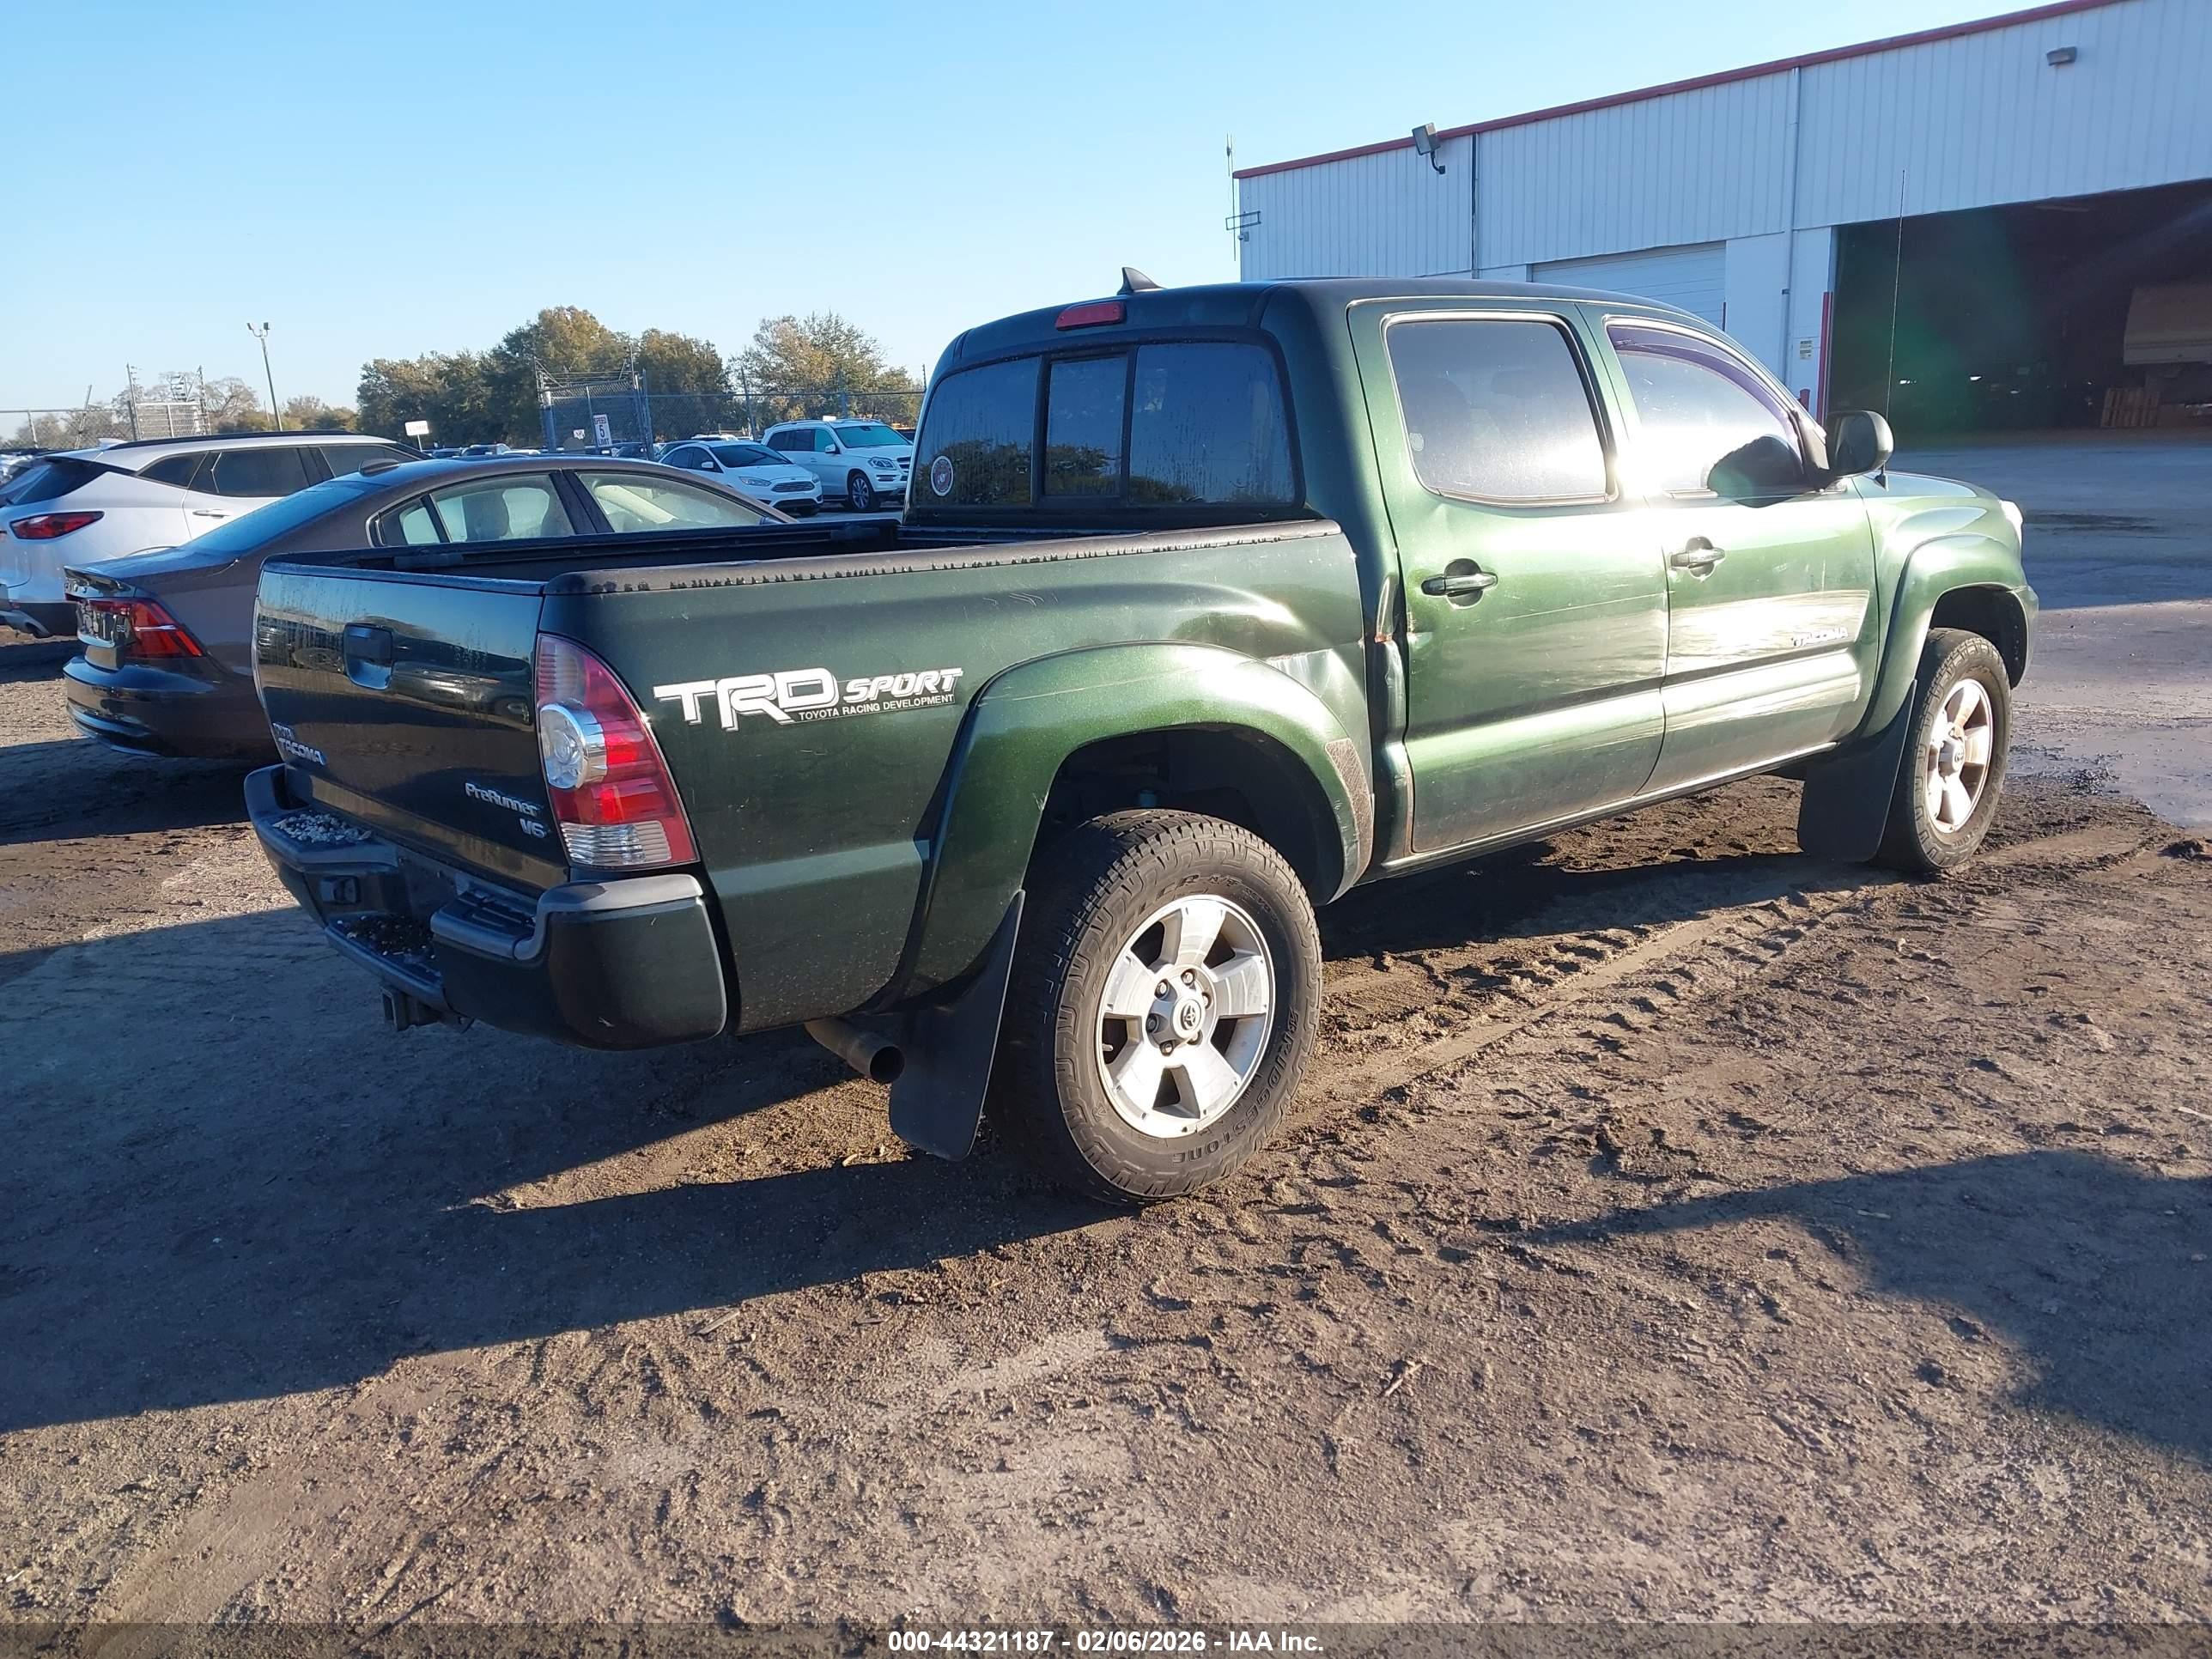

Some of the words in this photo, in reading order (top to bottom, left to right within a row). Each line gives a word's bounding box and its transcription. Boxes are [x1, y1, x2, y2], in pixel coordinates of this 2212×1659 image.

[599, 424, 605, 439] 5
[653, 667, 840, 732] TRD
[843, 667, 963, 703] SPORT
[799, 708, 840, 721] TOYOTA
[842, 702, 881, 715] RACING
[883, 694, 955, 710] DEVELOPMENT
[277, 737, 326, 766] TACOMA
[465, 782, 538, 817] PreRunner
[520, 817, 546, 839] V6
[1172, 1006, 1299, 1164] BRIDGESTONE
